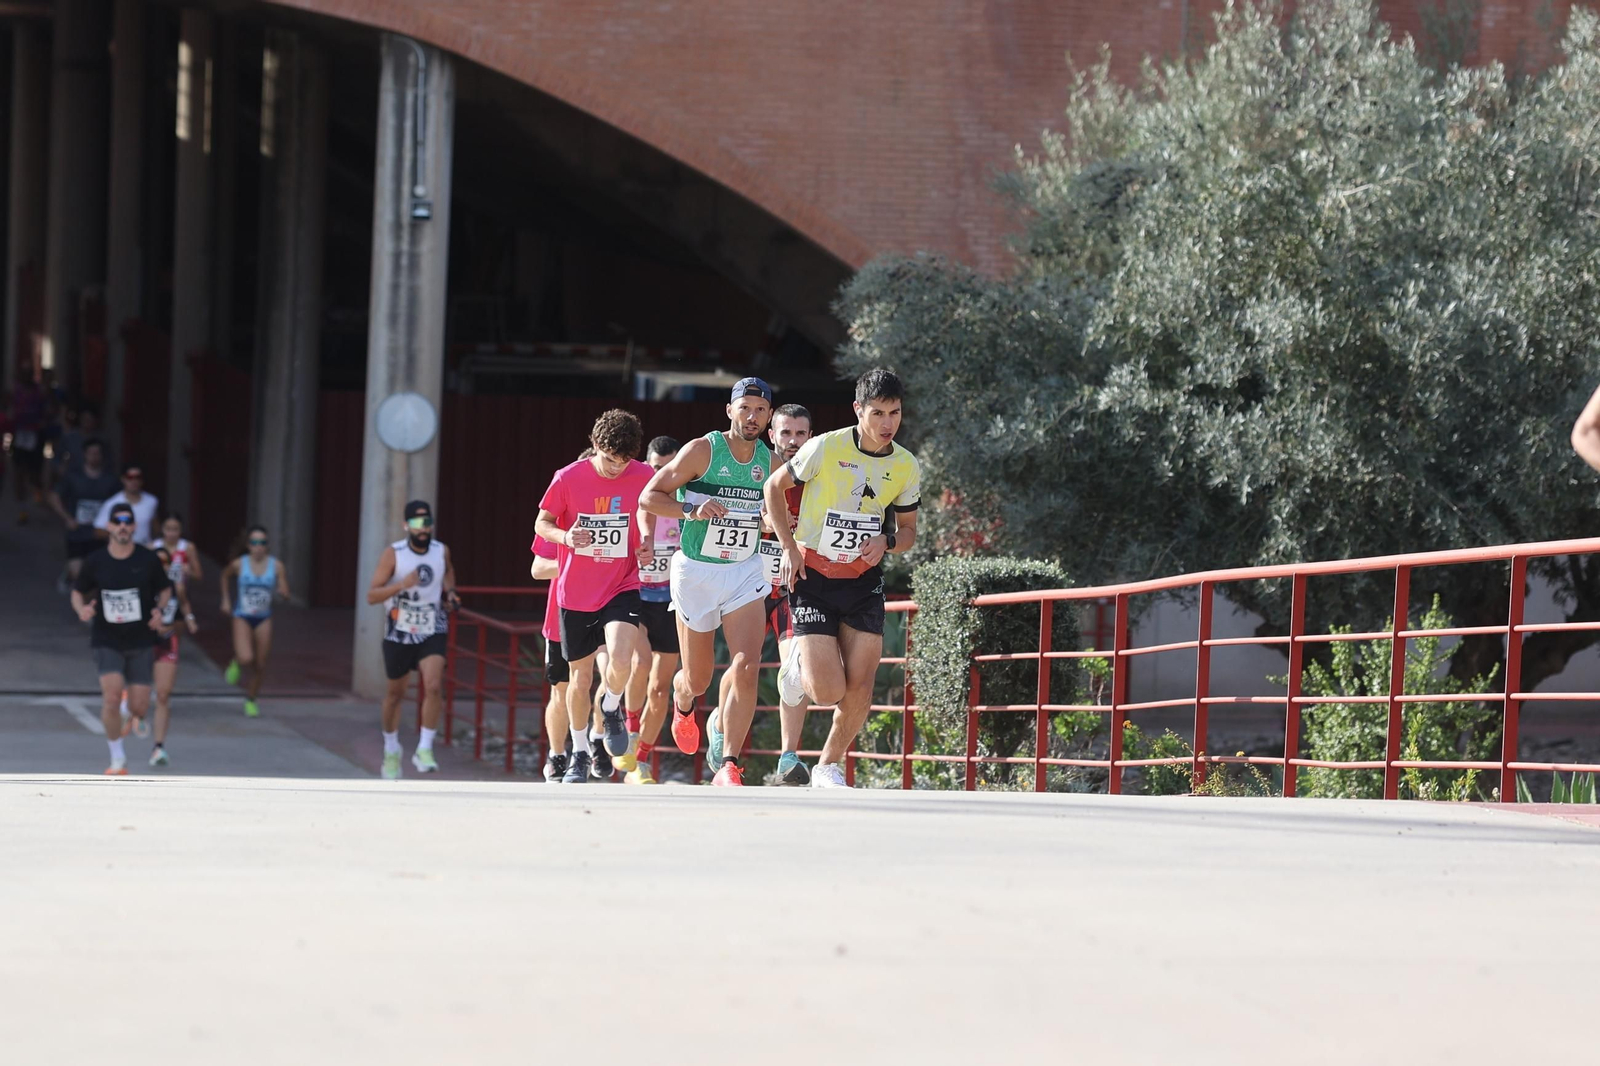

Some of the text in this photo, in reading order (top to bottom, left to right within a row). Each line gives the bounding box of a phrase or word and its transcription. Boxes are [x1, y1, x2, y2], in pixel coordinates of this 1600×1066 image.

[717, 487, 761, 500] ATLETISMO
[594, 496, 621, 514] WE
[580, 520, 603, 528] UMA
[713, 517, 735, 527] UMA
[828, 518, 853, 529] UMA
[715, 528, 749, 548] 131
[761, 546, 783, 556] UMA
[639, 558, 668, 571] 38
[404, 612, 429, 625] 215
